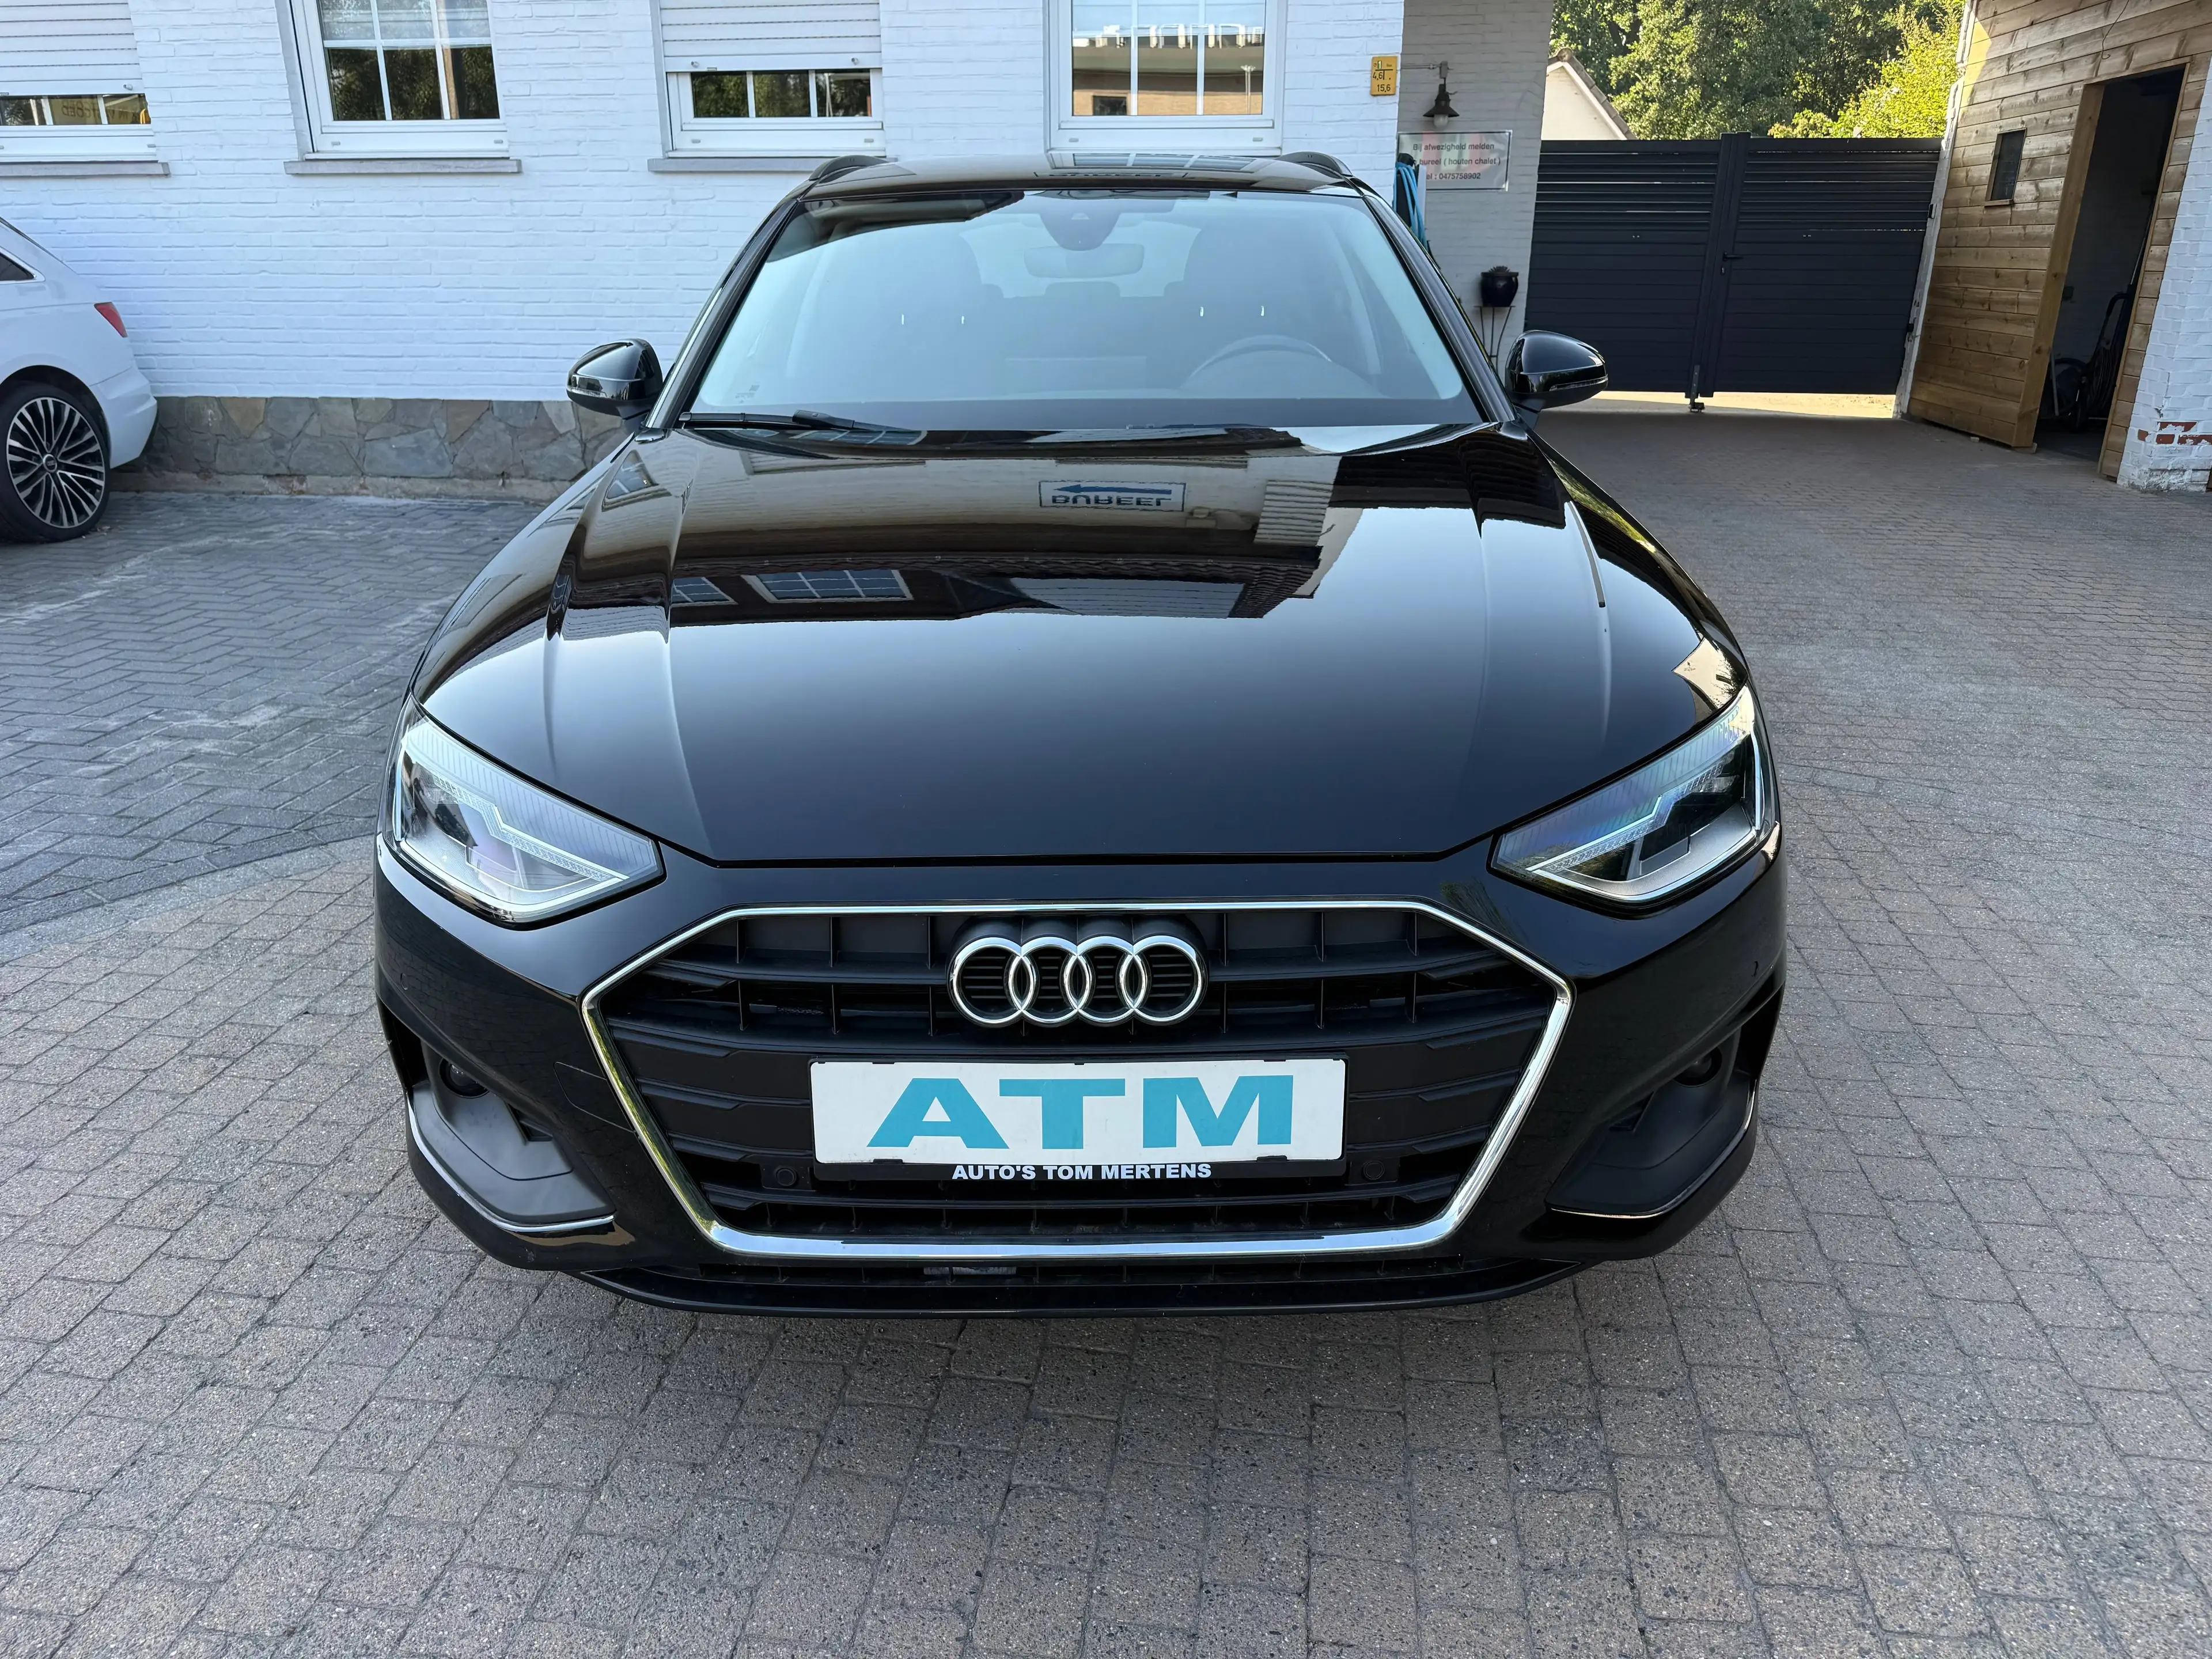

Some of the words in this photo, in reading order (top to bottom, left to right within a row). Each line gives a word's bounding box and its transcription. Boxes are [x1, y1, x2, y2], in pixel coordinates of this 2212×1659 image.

[1413, 144, 1422, 152] Bij
[1424, 143, 1466, 151] afwezigheid
[867, 1075, 1294, 1149] ATM
[952, 1165, 1036, 1180] AUTO'S
[1043, 1165, 1093, 1180] TOM
[1101, 1164, 1211, 1180] MERTENS
